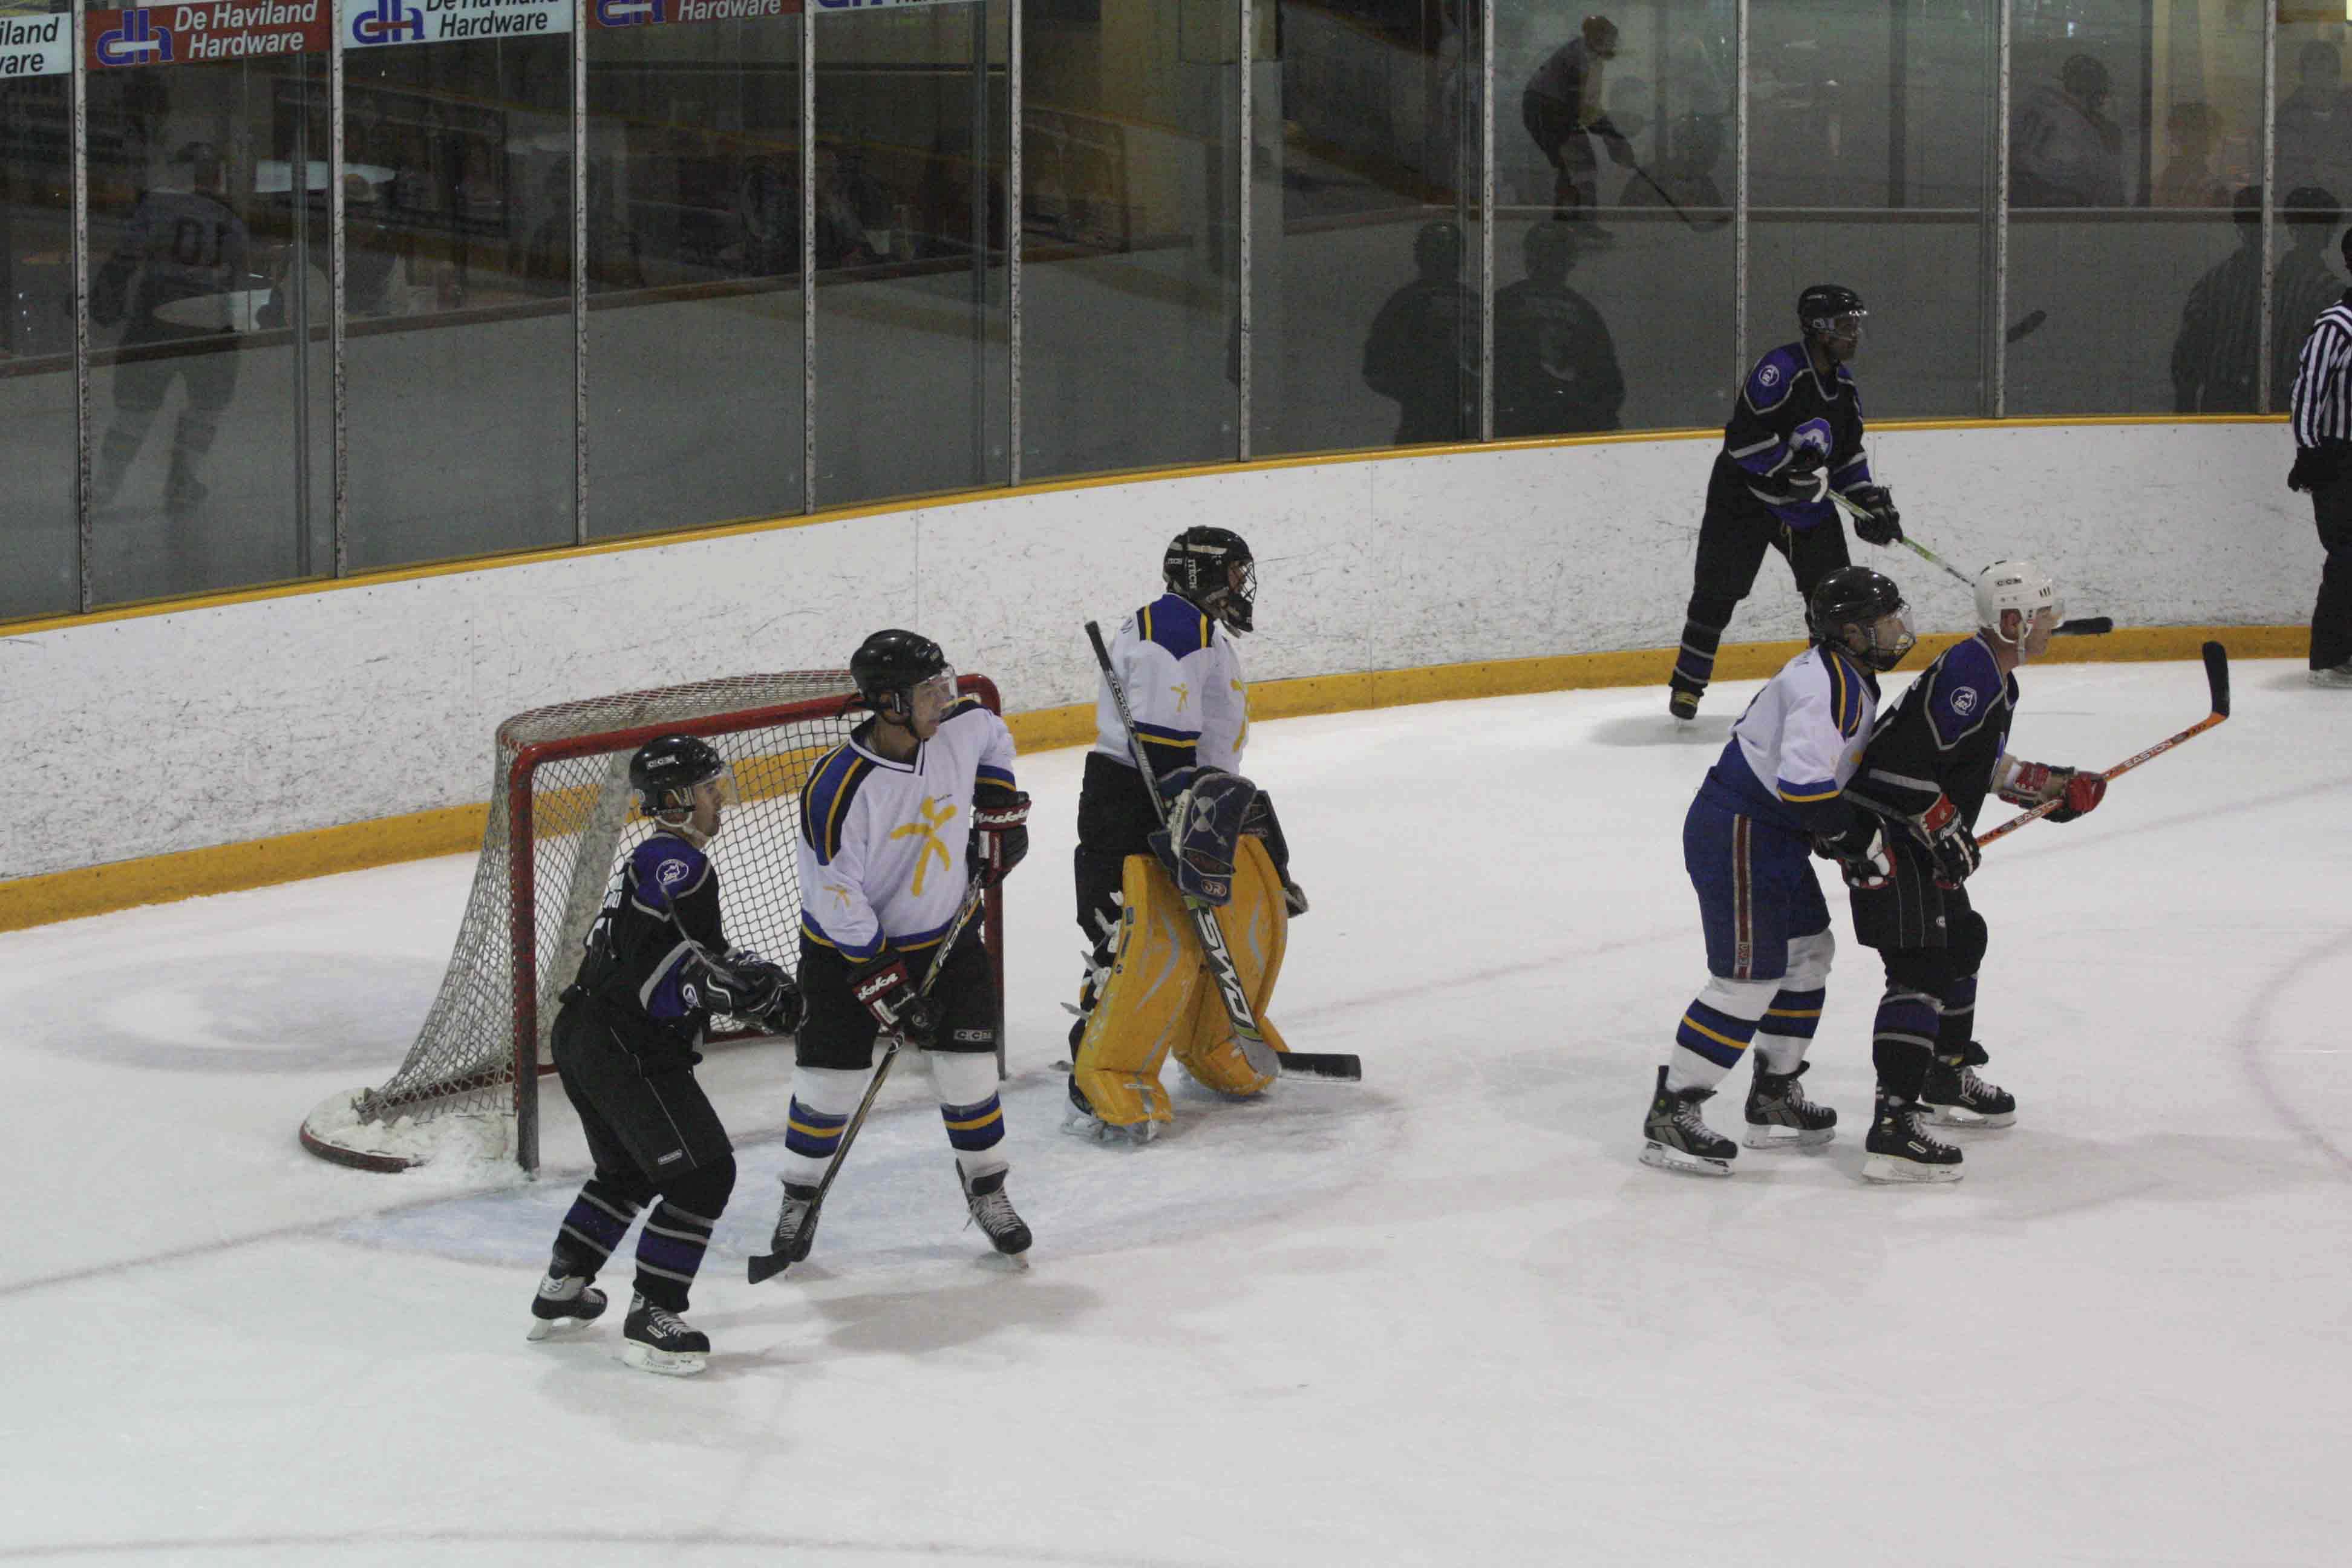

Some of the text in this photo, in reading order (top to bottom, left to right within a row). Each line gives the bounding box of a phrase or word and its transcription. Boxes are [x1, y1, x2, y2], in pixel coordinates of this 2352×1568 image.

[174, 0, 318, 32] De Haviland
[439, 10, 548, 38] Hardware
[678, 0, 781, 21] Hardware
[188, 30, 304, 59] Hardware
[0, 53, 44, 74] are
[2123, 740, 2174, 768] EASTON
[2014, 799, 2063, 825] EASTO
